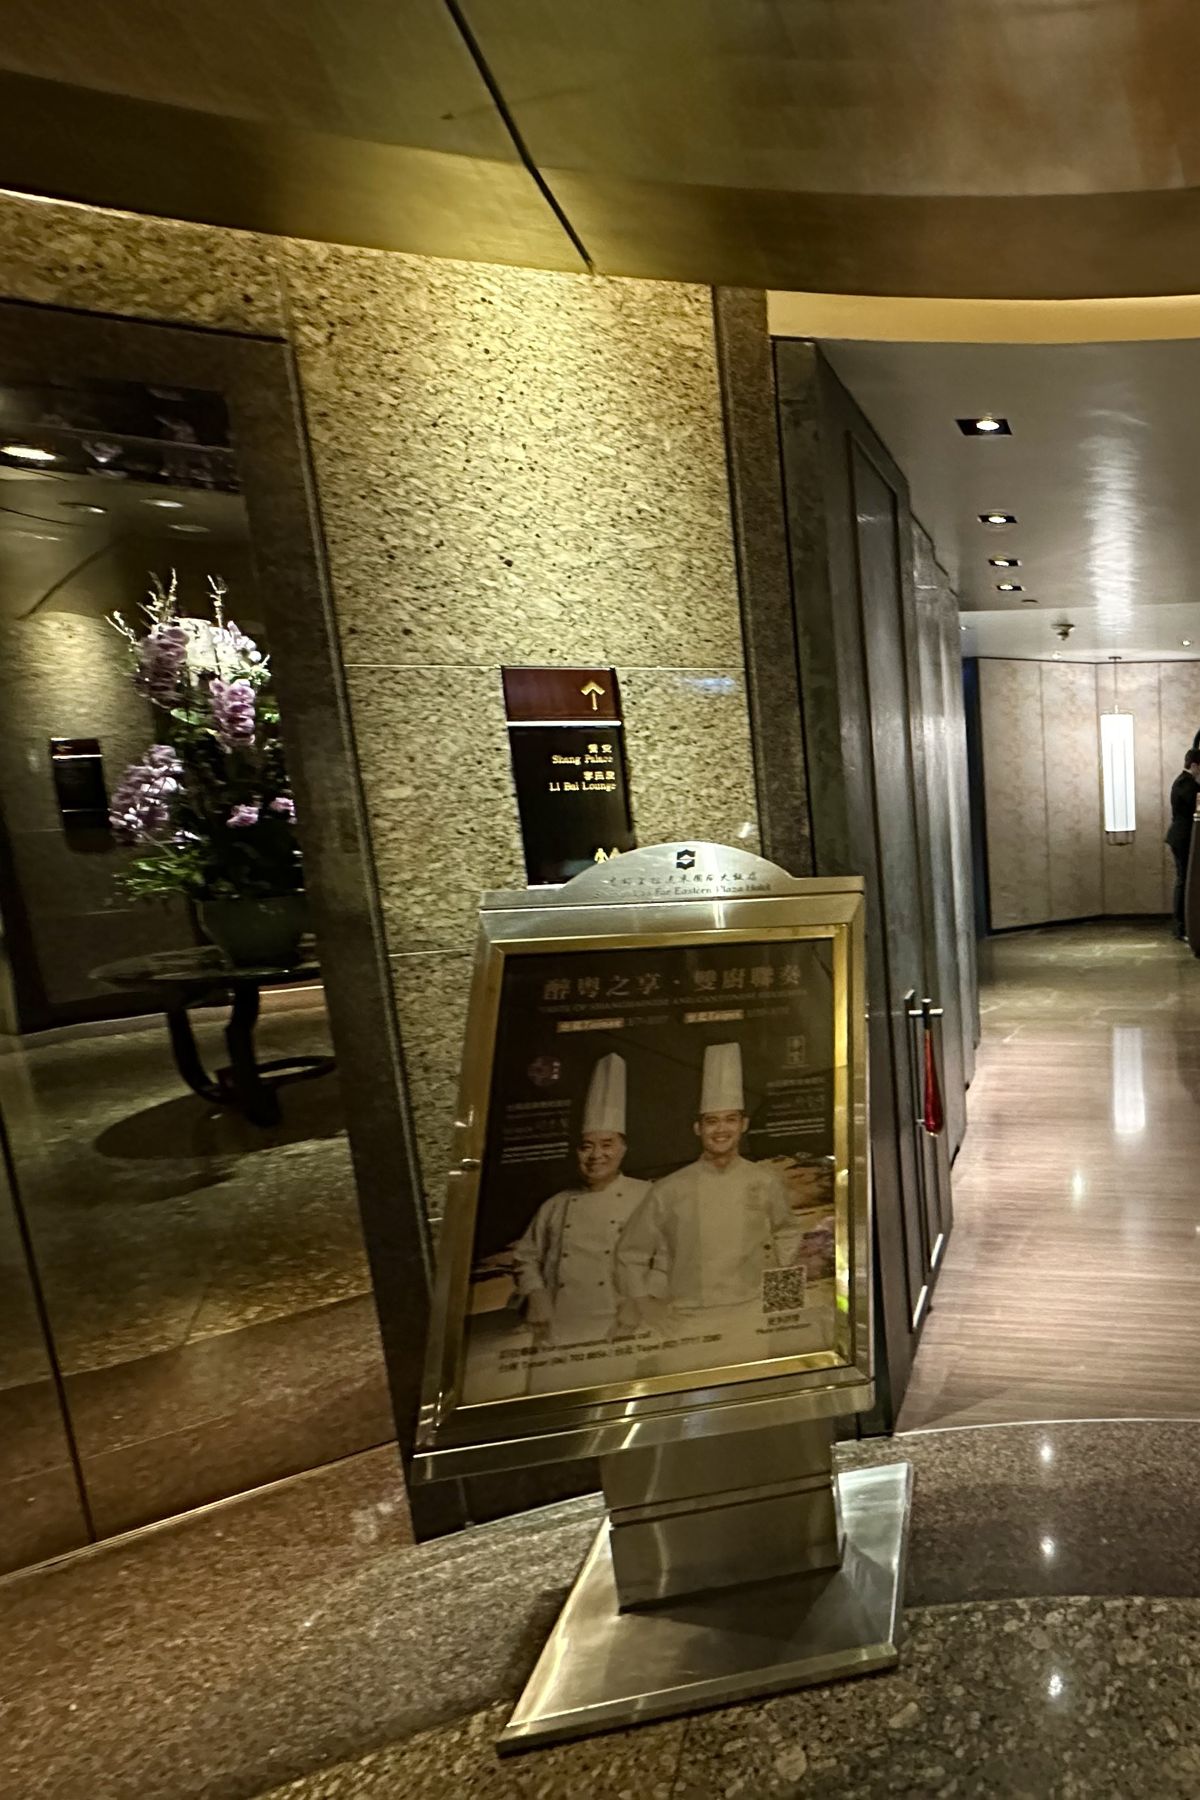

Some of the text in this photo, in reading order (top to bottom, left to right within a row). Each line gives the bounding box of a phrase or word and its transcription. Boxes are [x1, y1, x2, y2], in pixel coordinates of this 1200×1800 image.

[551, 754, 614, 766] Shang Palace
[581, 781, 617, 792] Lounge
[674, 885, 712, 896] Eastern
